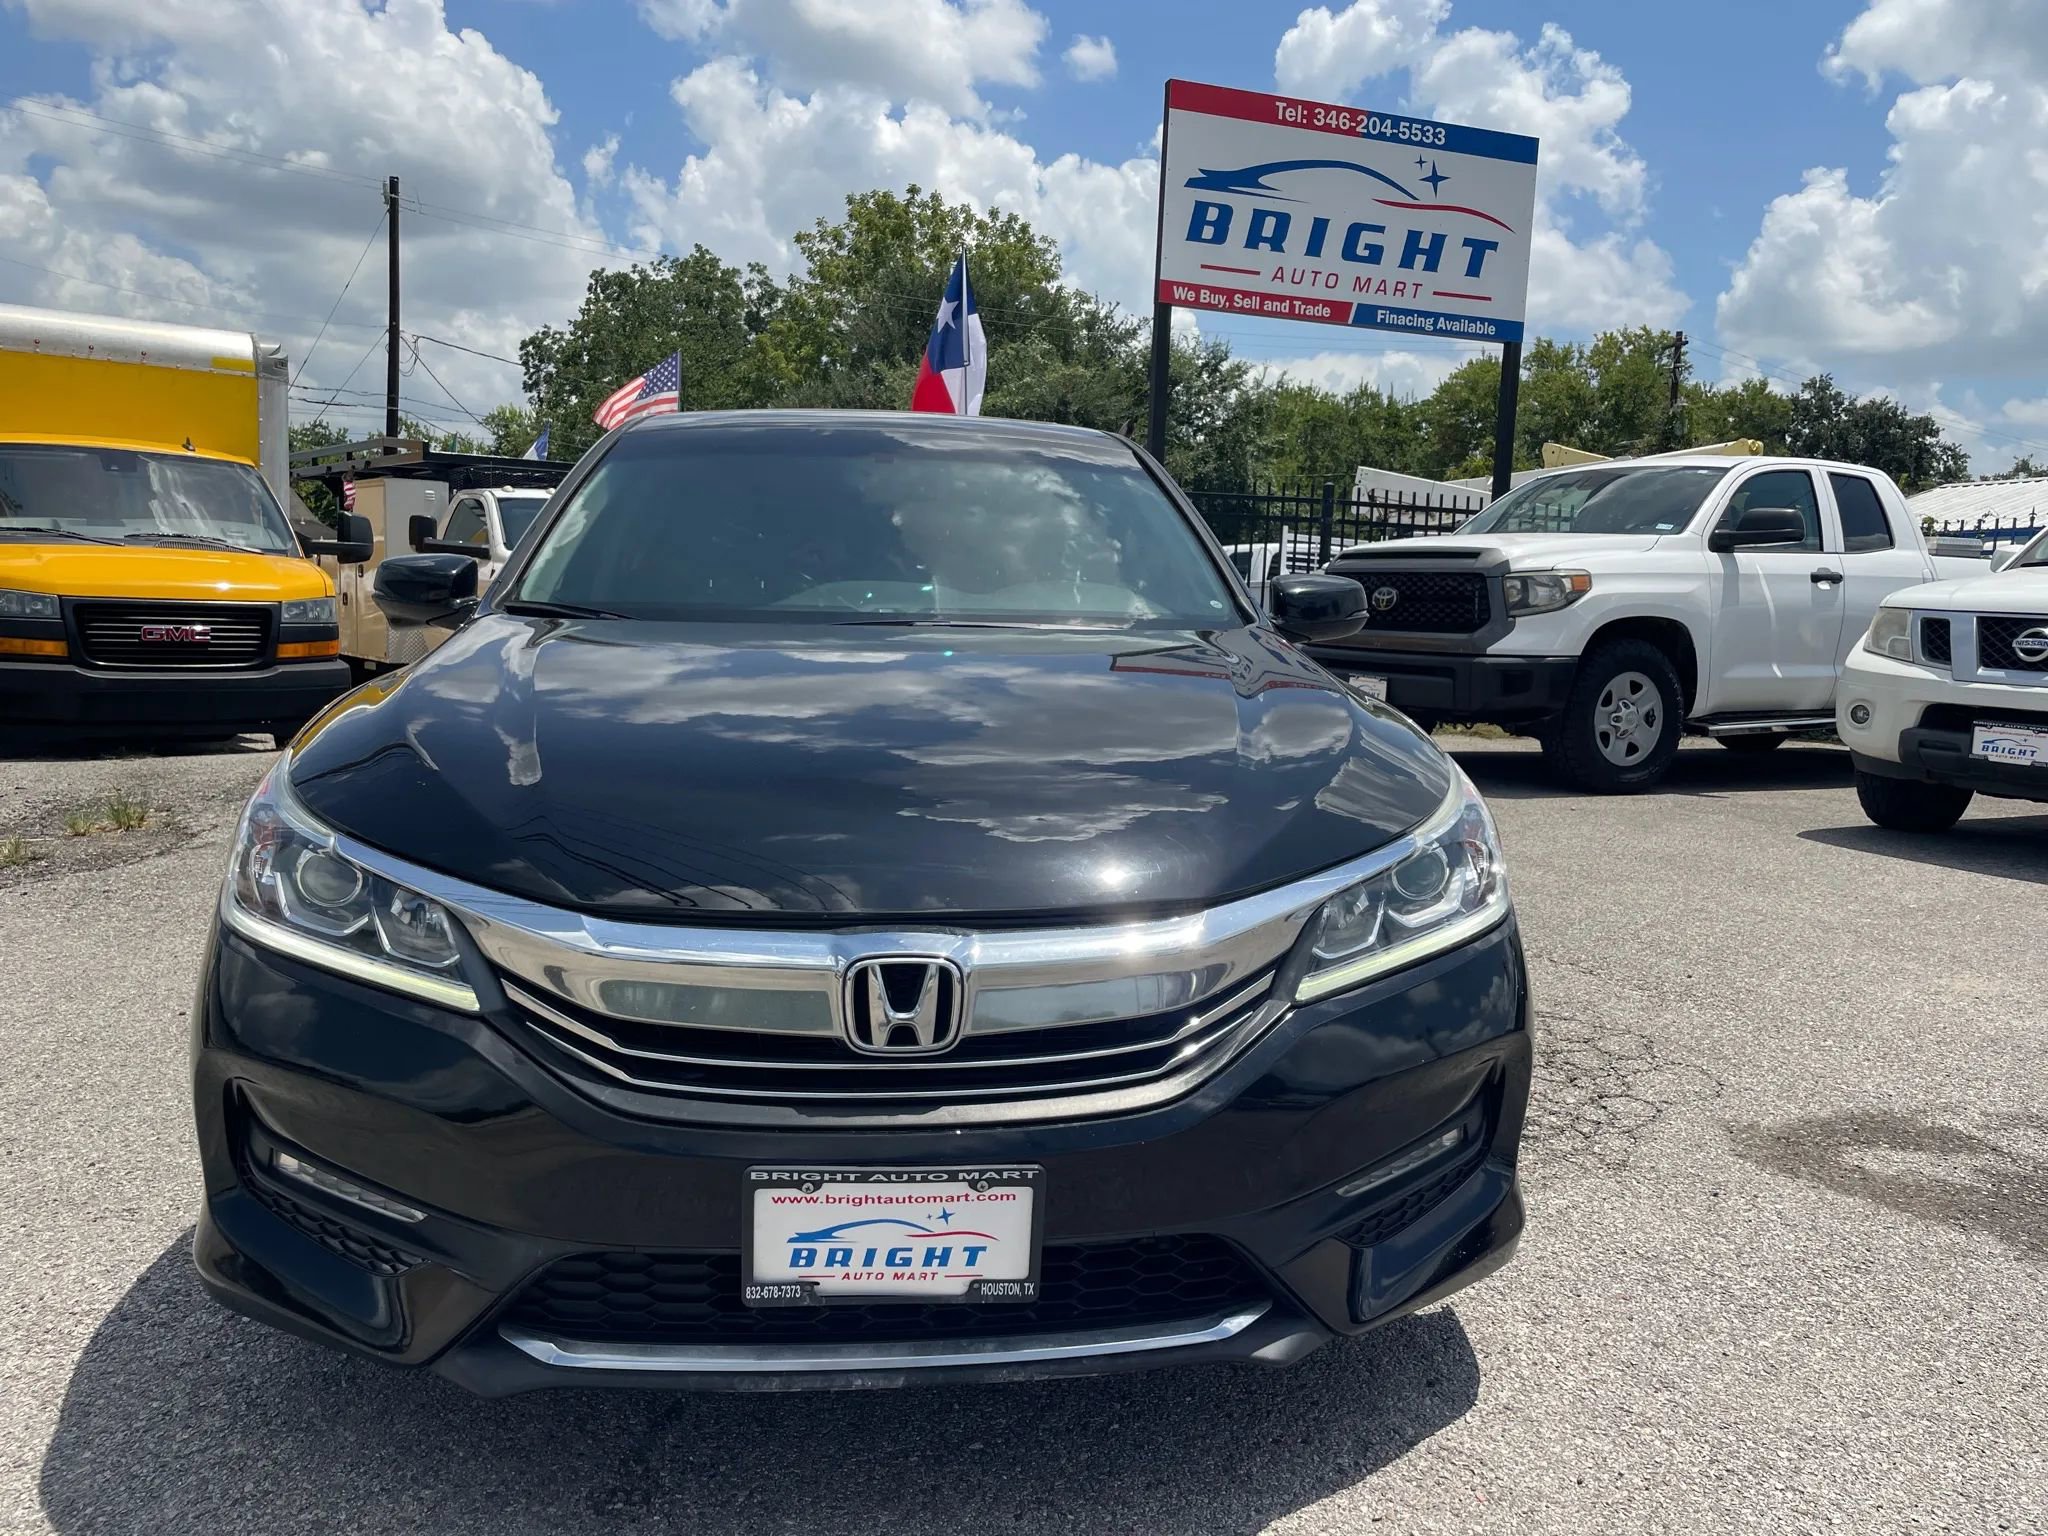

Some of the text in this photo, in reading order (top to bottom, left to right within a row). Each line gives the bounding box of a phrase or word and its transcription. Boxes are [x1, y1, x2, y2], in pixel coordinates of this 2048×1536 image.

[1275, 102, 1445, 145] Tel: 346-204-5533
[1185, 200, 1499, 278] BRIGHT
[1271, 266, 1423, 299] AUTO MART
[1173, 285, 1331, 318] We Buy, Sell and Trade
[1377, 310, 1496, 335] Finacing Available
[141, 625, 211, 641] GMC
[1982, 745, 2037, 757] BRIGHT
[751, 1171, 1039, 1181] BRIGHT AUTO MART
[772, 1191, 1016, 1206] www.brightautomart.com
[789, 1246, 987, 1268] BRIGHT
[842, 1272, 938, 1280] AUTO MART
[746, 1286, 800, 1299] 832-678-7373
[981, 1283, 1034, 1296] HOUSTON, TX
